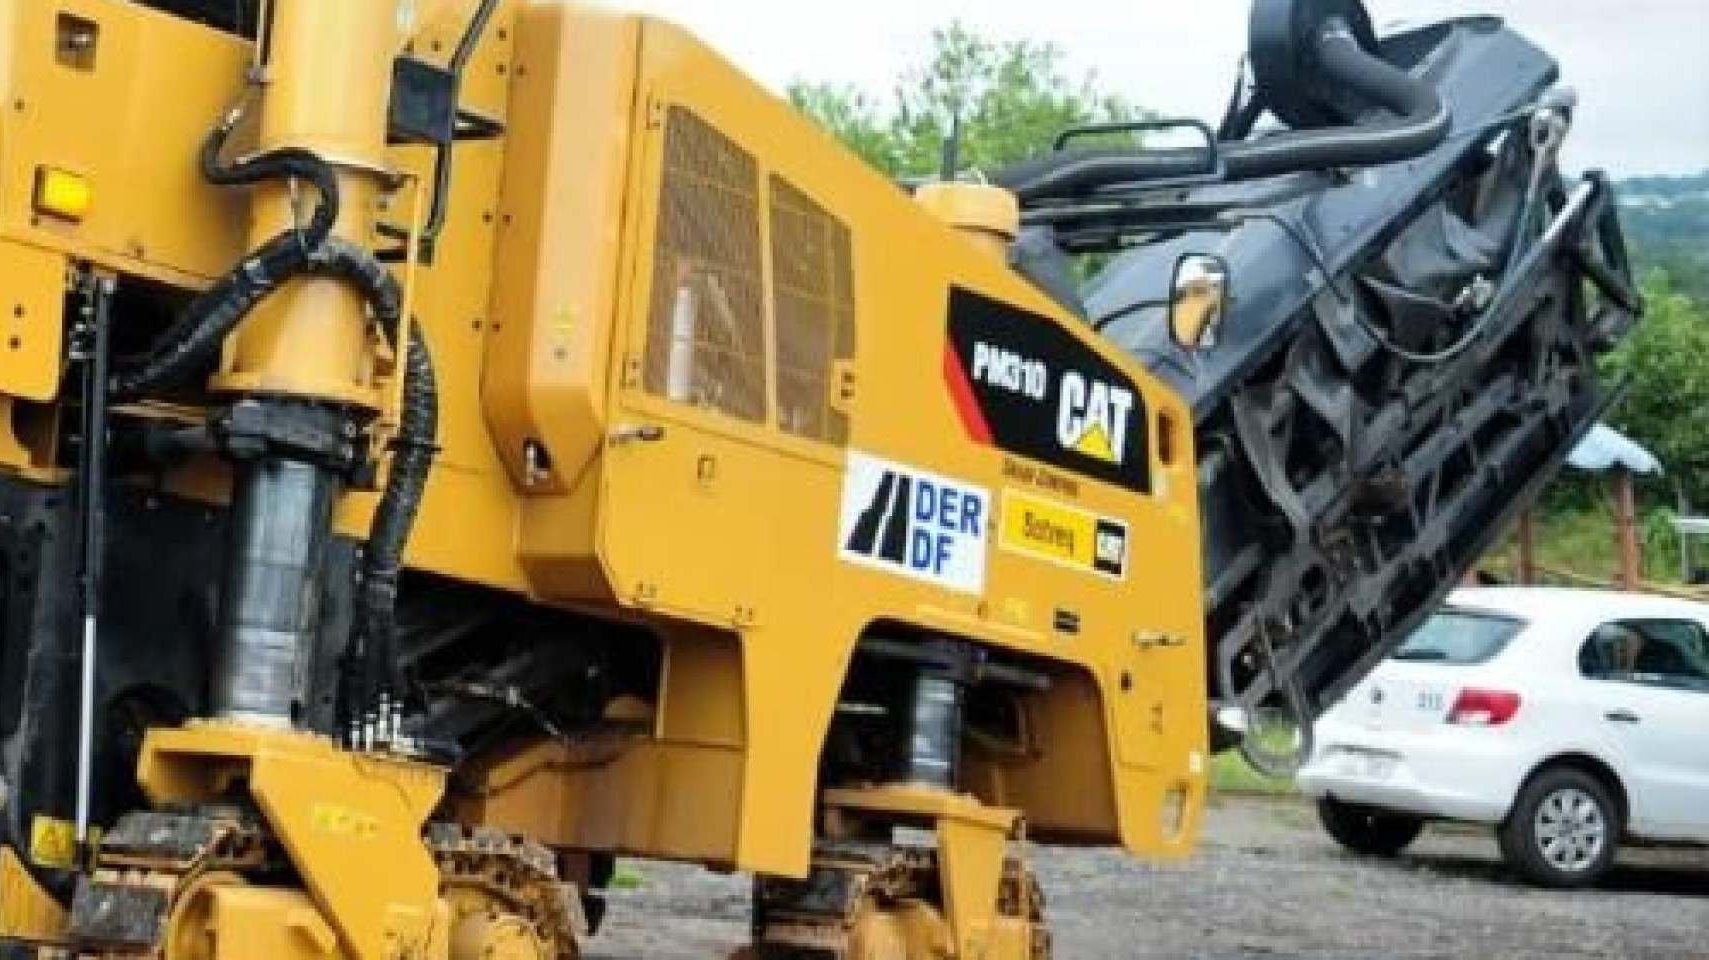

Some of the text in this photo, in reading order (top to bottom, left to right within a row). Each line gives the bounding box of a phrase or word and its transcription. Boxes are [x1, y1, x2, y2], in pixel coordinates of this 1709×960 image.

[973, 341, 1133, 465] PM310 CAT
[915, 478, 982, 537] DER
[911, 528, 955, 575] DF
